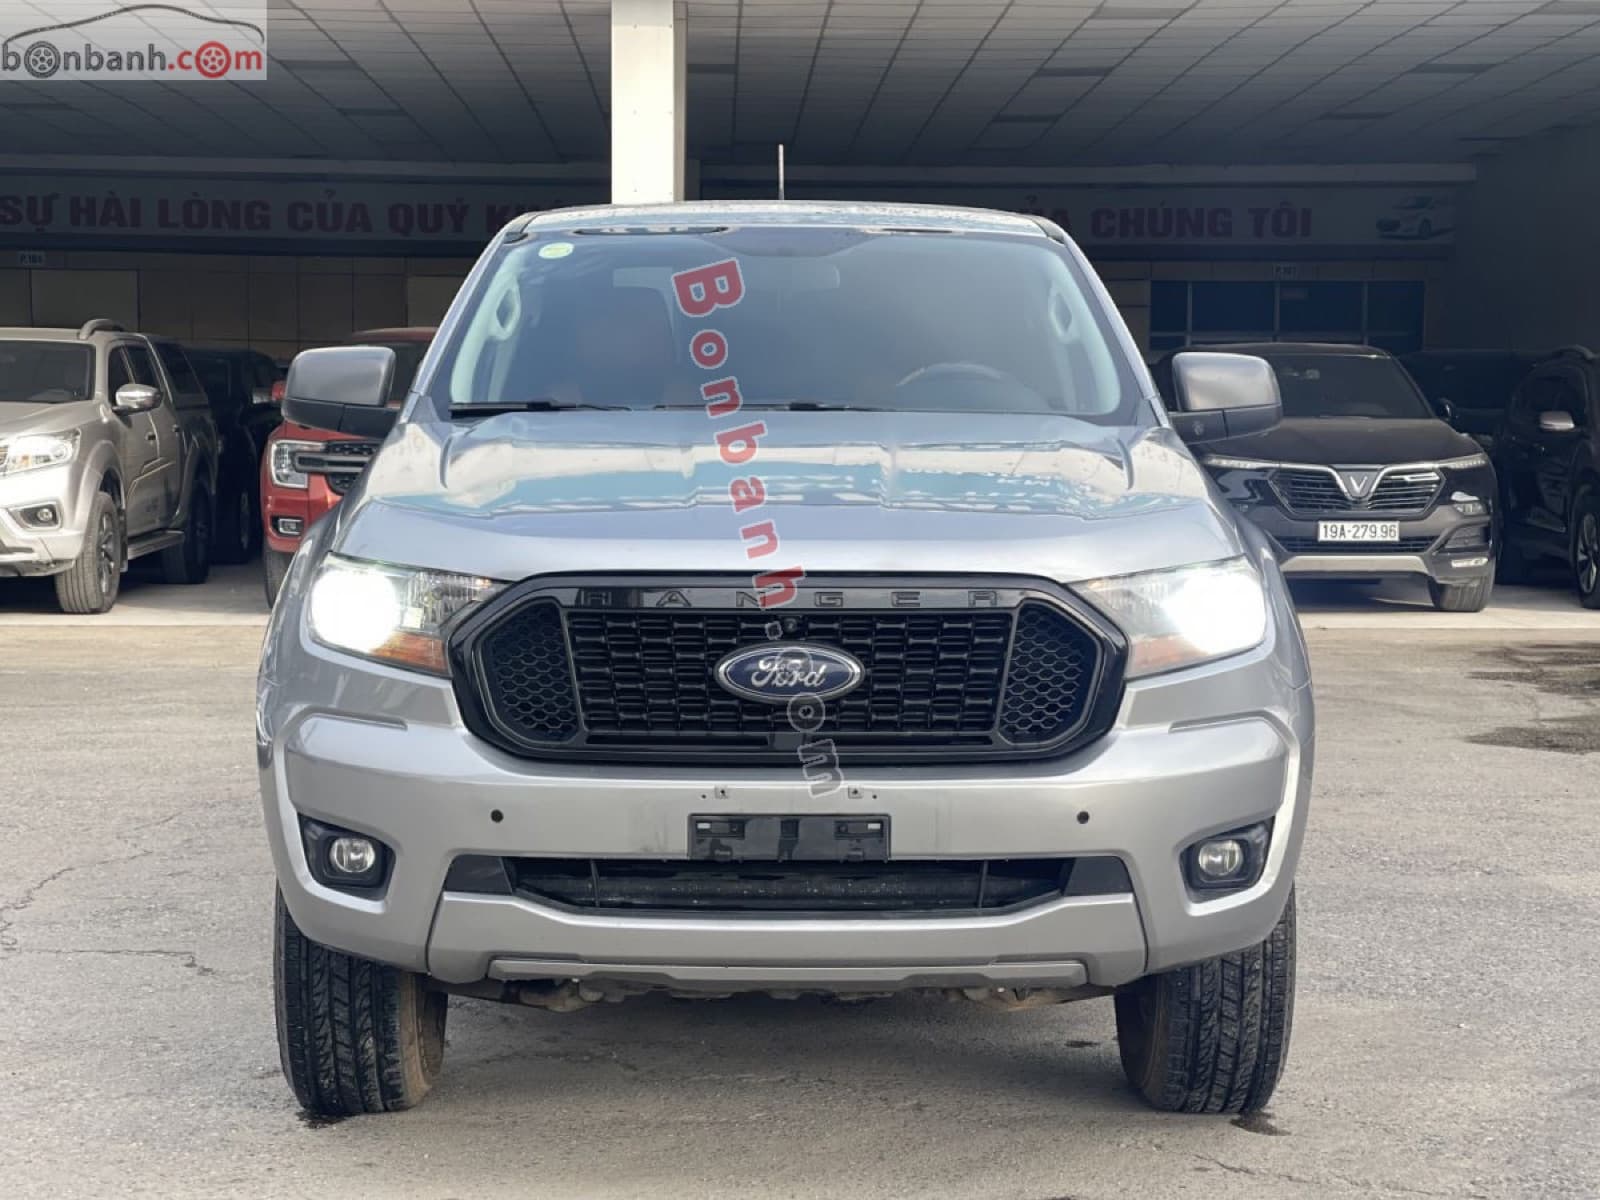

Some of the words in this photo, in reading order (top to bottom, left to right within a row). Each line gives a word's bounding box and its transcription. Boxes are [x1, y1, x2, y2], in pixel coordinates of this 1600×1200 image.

[0, 193, 60, 232] SỰ
[69, 190, 144, 228] HÀI
[158, 192, 272, 231] LÒNG
[287, 190, 373, 233] CỦA
[388, 197, 471, 237] QUÝ
[1090, 201, 1233, 238] CHÚNG
[1248, 201, 1312, 238] TÔI
[581, 589, 998, 607] RANGER
[751, 658, 826, 687] Ford
